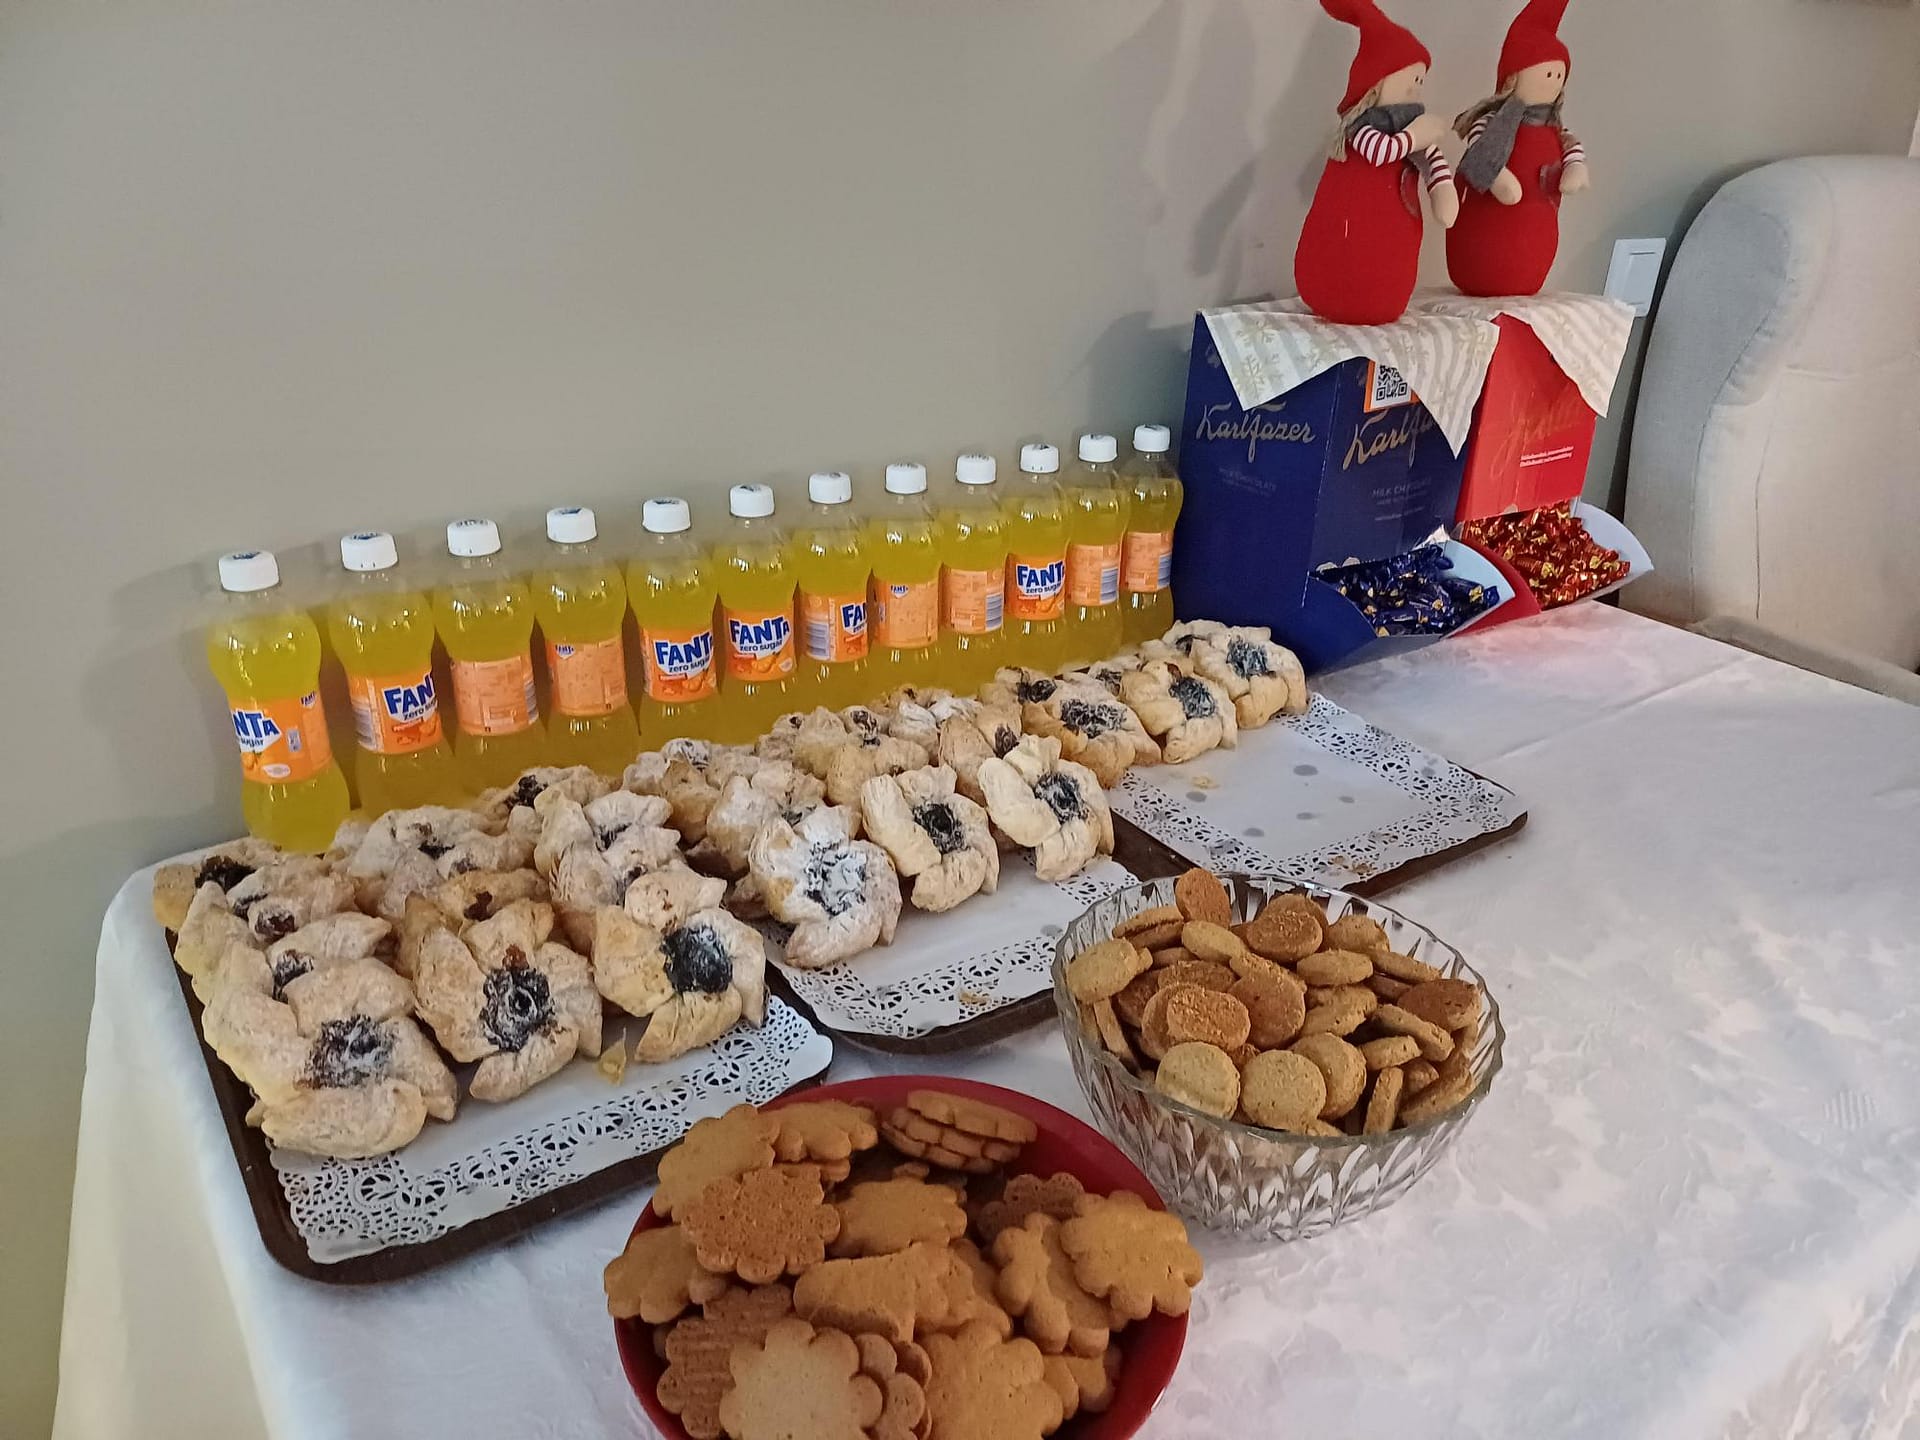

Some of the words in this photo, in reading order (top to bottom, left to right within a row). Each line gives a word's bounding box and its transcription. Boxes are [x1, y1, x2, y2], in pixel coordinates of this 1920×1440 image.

[730, 616, 790, 645] FANTA
[669, 665, 689, 673] zero
[384, 673, 434, 715] FAN
[233, 710, 280, 739] NTA
[403, 708, 424, 721] zero
